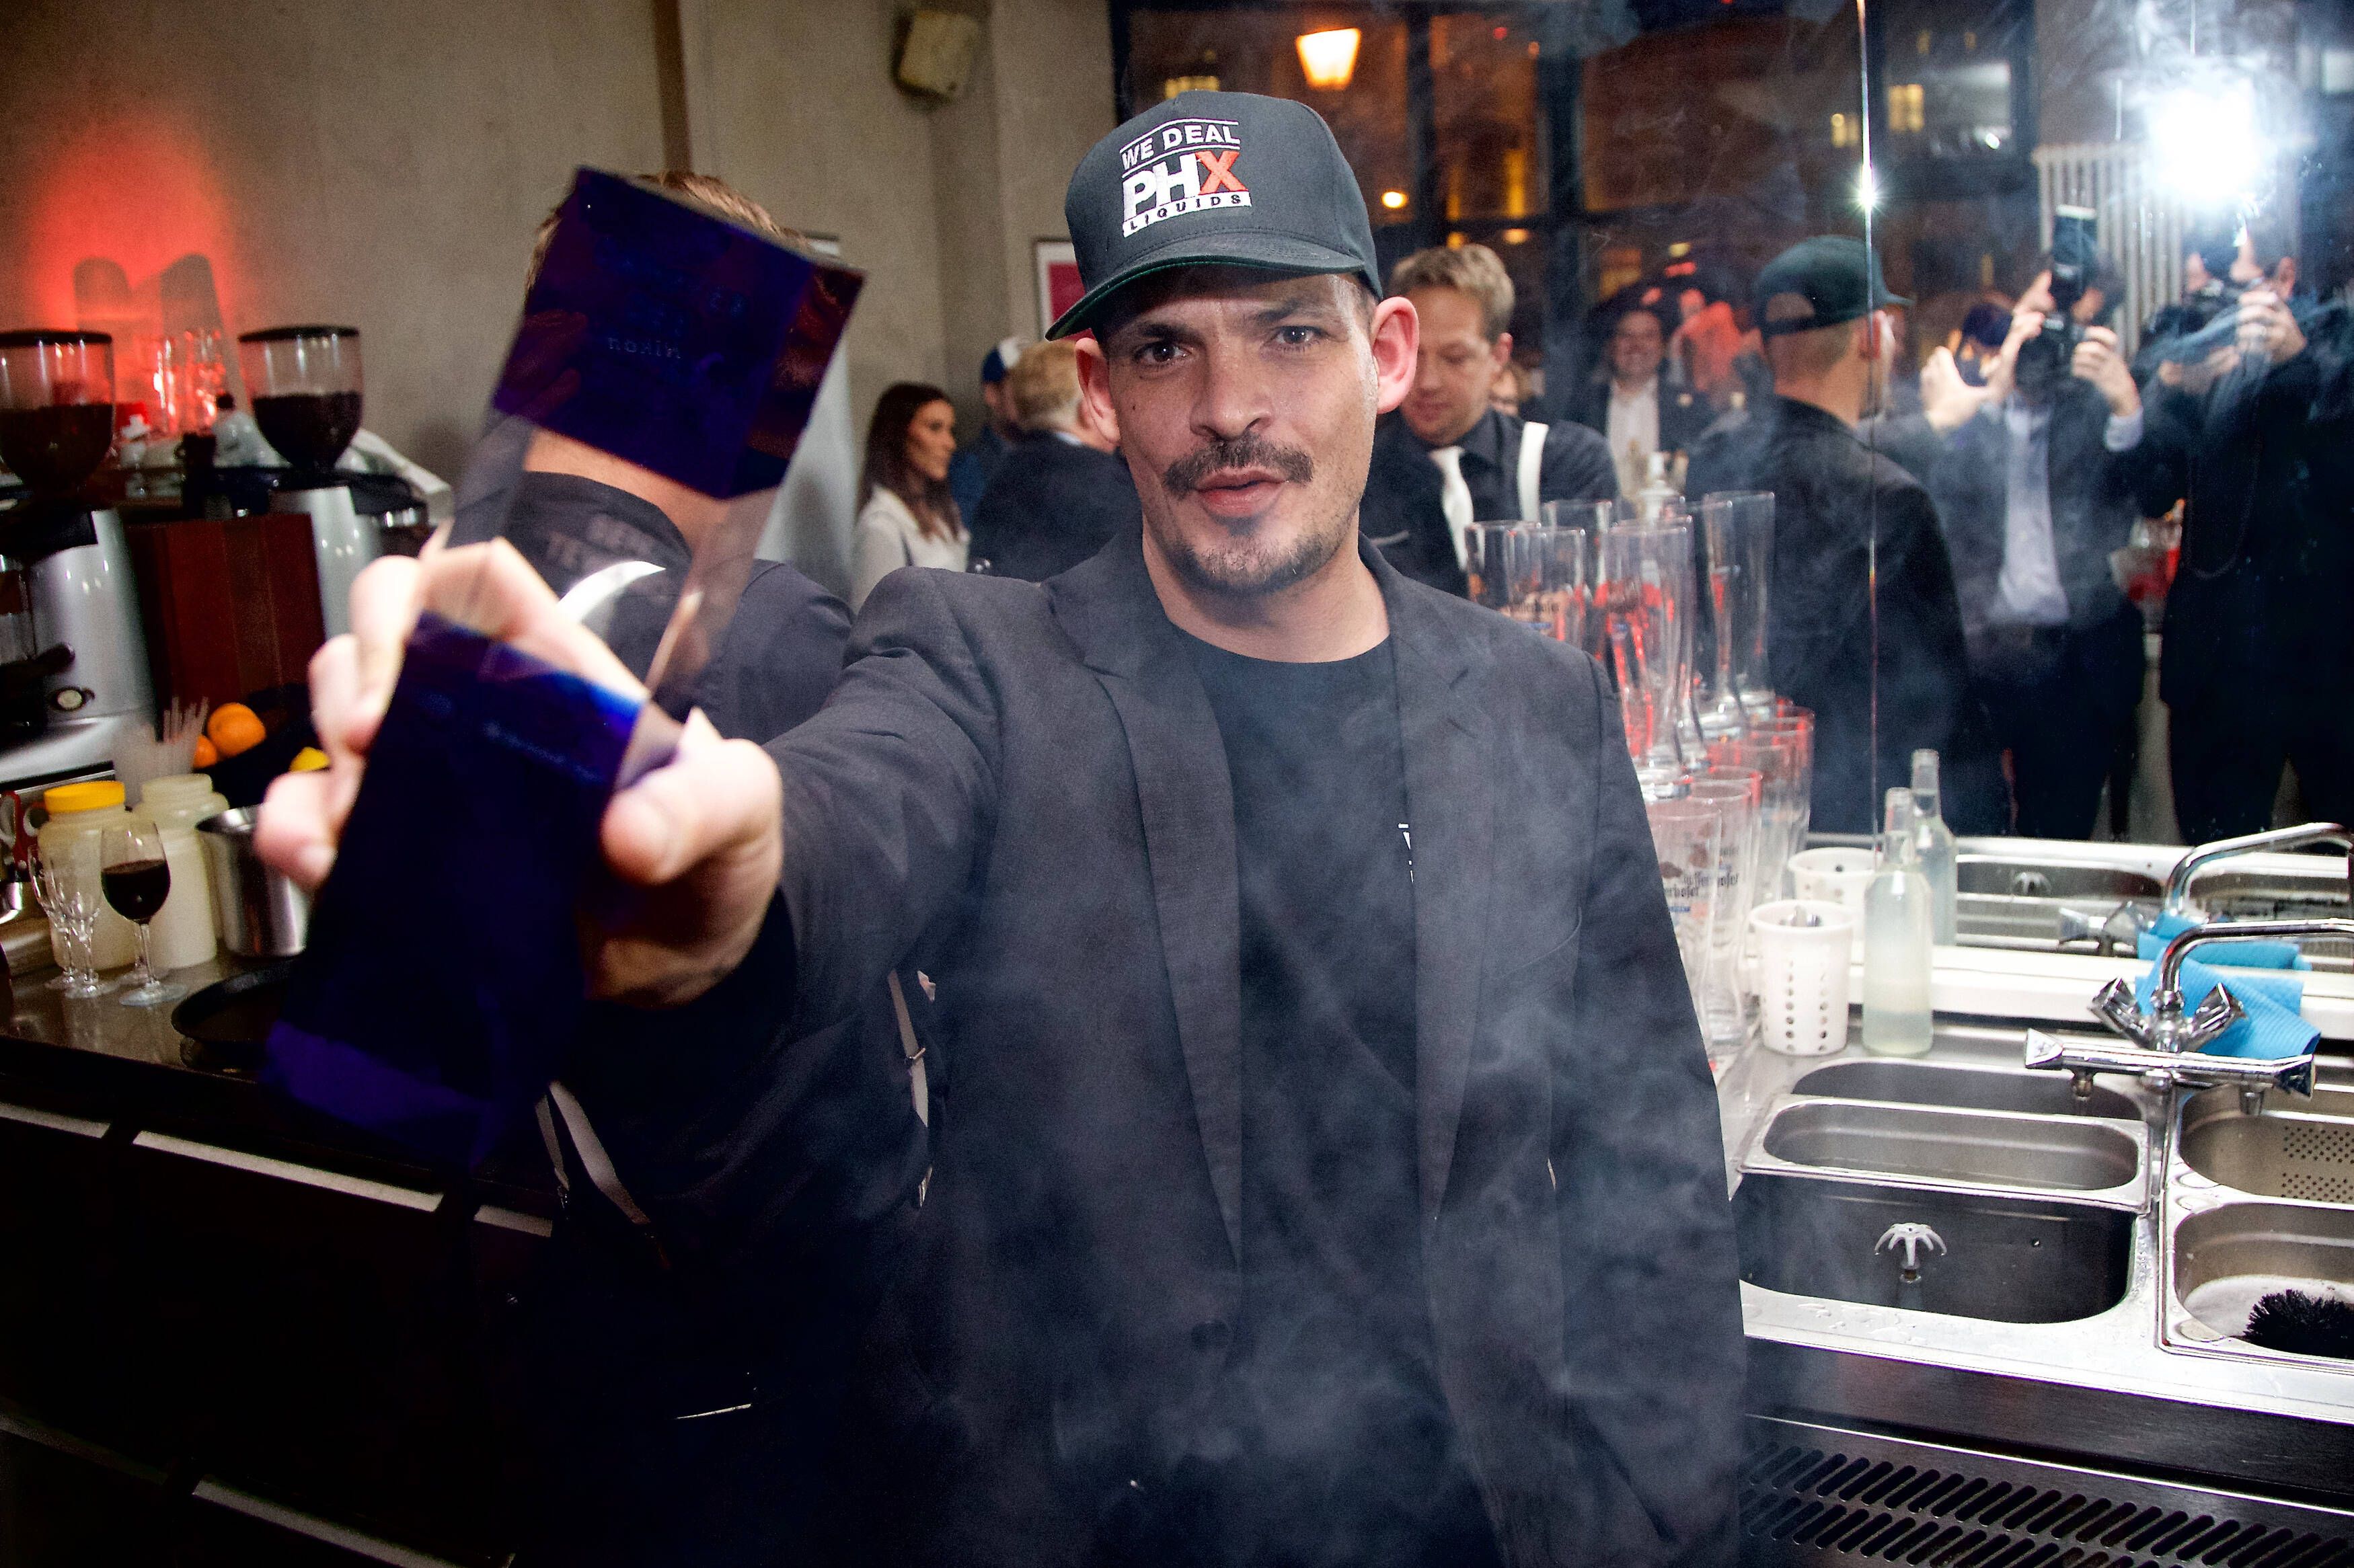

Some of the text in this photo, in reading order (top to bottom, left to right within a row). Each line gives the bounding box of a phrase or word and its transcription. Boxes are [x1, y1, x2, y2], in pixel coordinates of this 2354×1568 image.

[1121, 124, 1241, 170] WE DEAL
[1122, 150, 1249, 223] PHX
[1130, 194, 1242, 231] LIQUIDS
